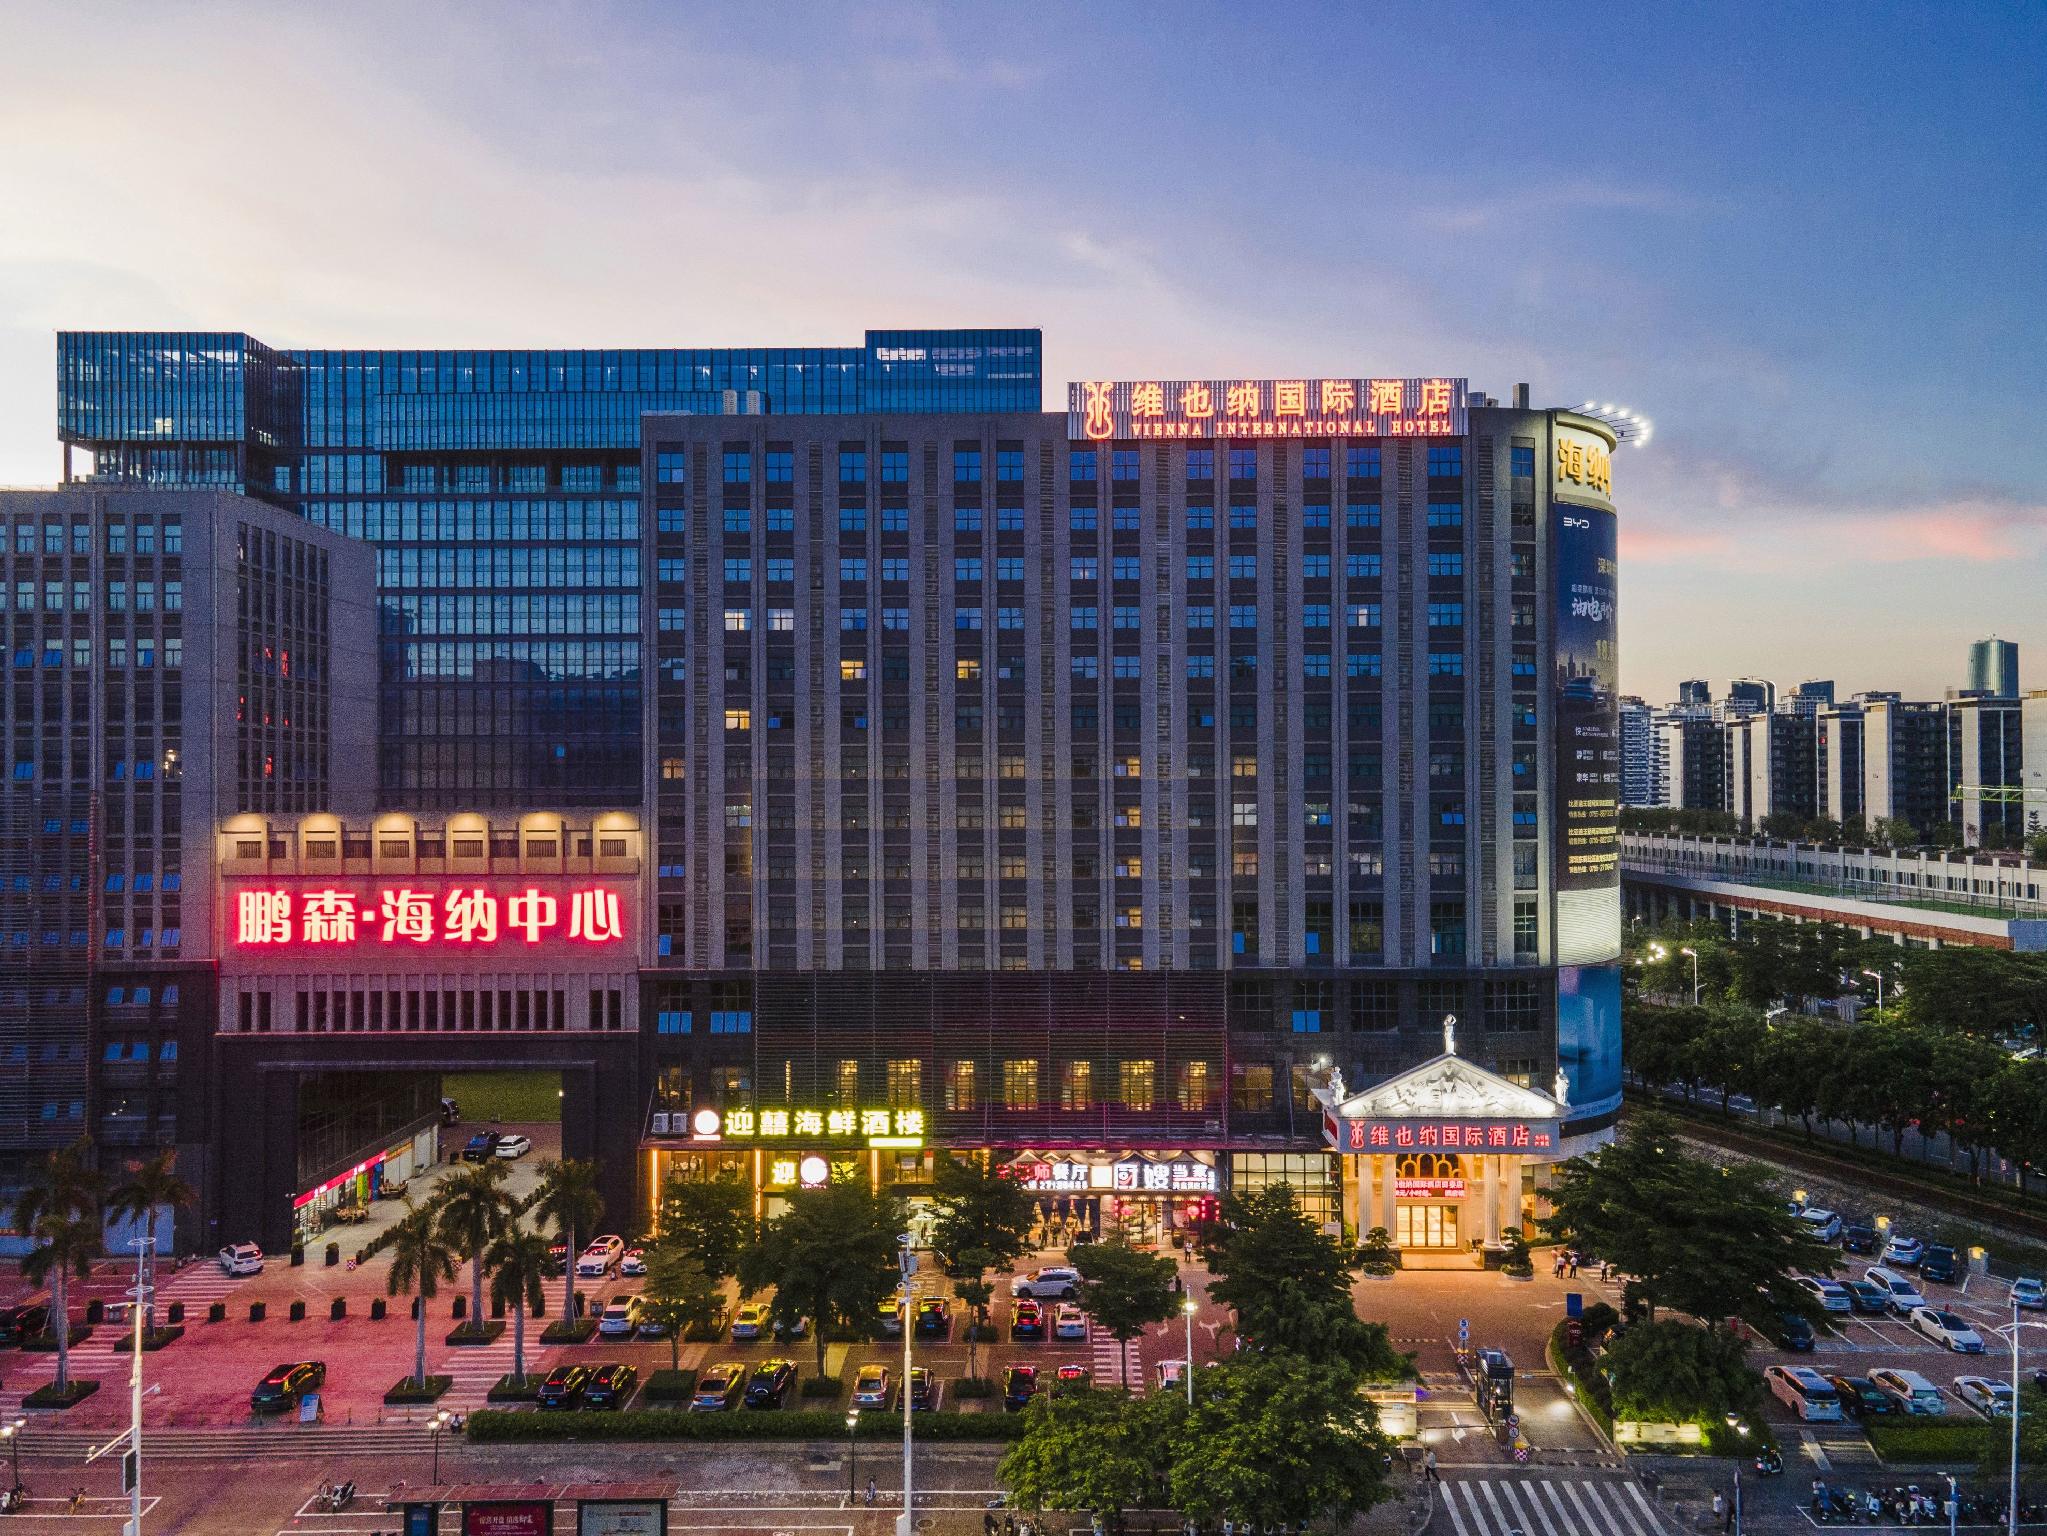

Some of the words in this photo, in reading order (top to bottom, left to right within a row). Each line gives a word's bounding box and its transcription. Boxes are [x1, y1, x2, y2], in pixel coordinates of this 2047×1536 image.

[1131, 381, 1452, 418] 维也纳国际酒店
[1131, 420, 1202, 437] VIENNA
[1216, 419, 1377, 435] INTERNATIONAL
[1391, 417, 1452, 434] HOTEL
[1563, 518, 1589, 528] BYD
[237, 889, 623, 944] 鹏森·海纳中心
[1370, 1124, 1530, 1147] 维也纳国际酒店
